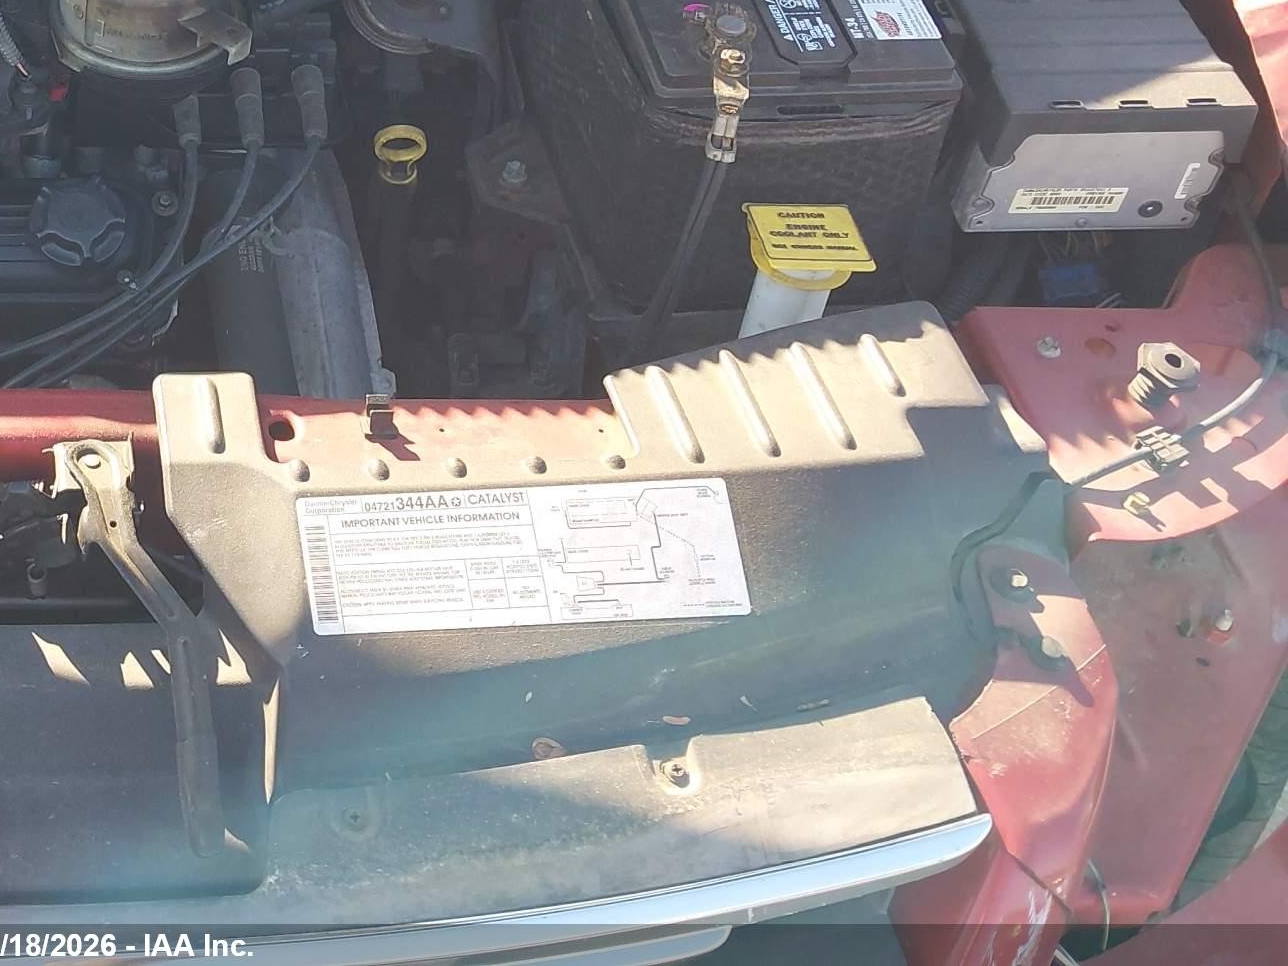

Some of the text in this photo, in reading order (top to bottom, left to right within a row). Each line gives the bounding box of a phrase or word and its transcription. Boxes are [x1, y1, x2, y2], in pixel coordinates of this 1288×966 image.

[769, 5, 789, 34] DANGER
[844, 17, 865, 39] MT-34
[364, 495, 449, 512] 04721344AA
[467, 491, 525, 505] CATALYST
[305, 506, 345, 515] Corporation
[341, 512, 520, 528] IMPORTANT VEHICLE INFORMATION
